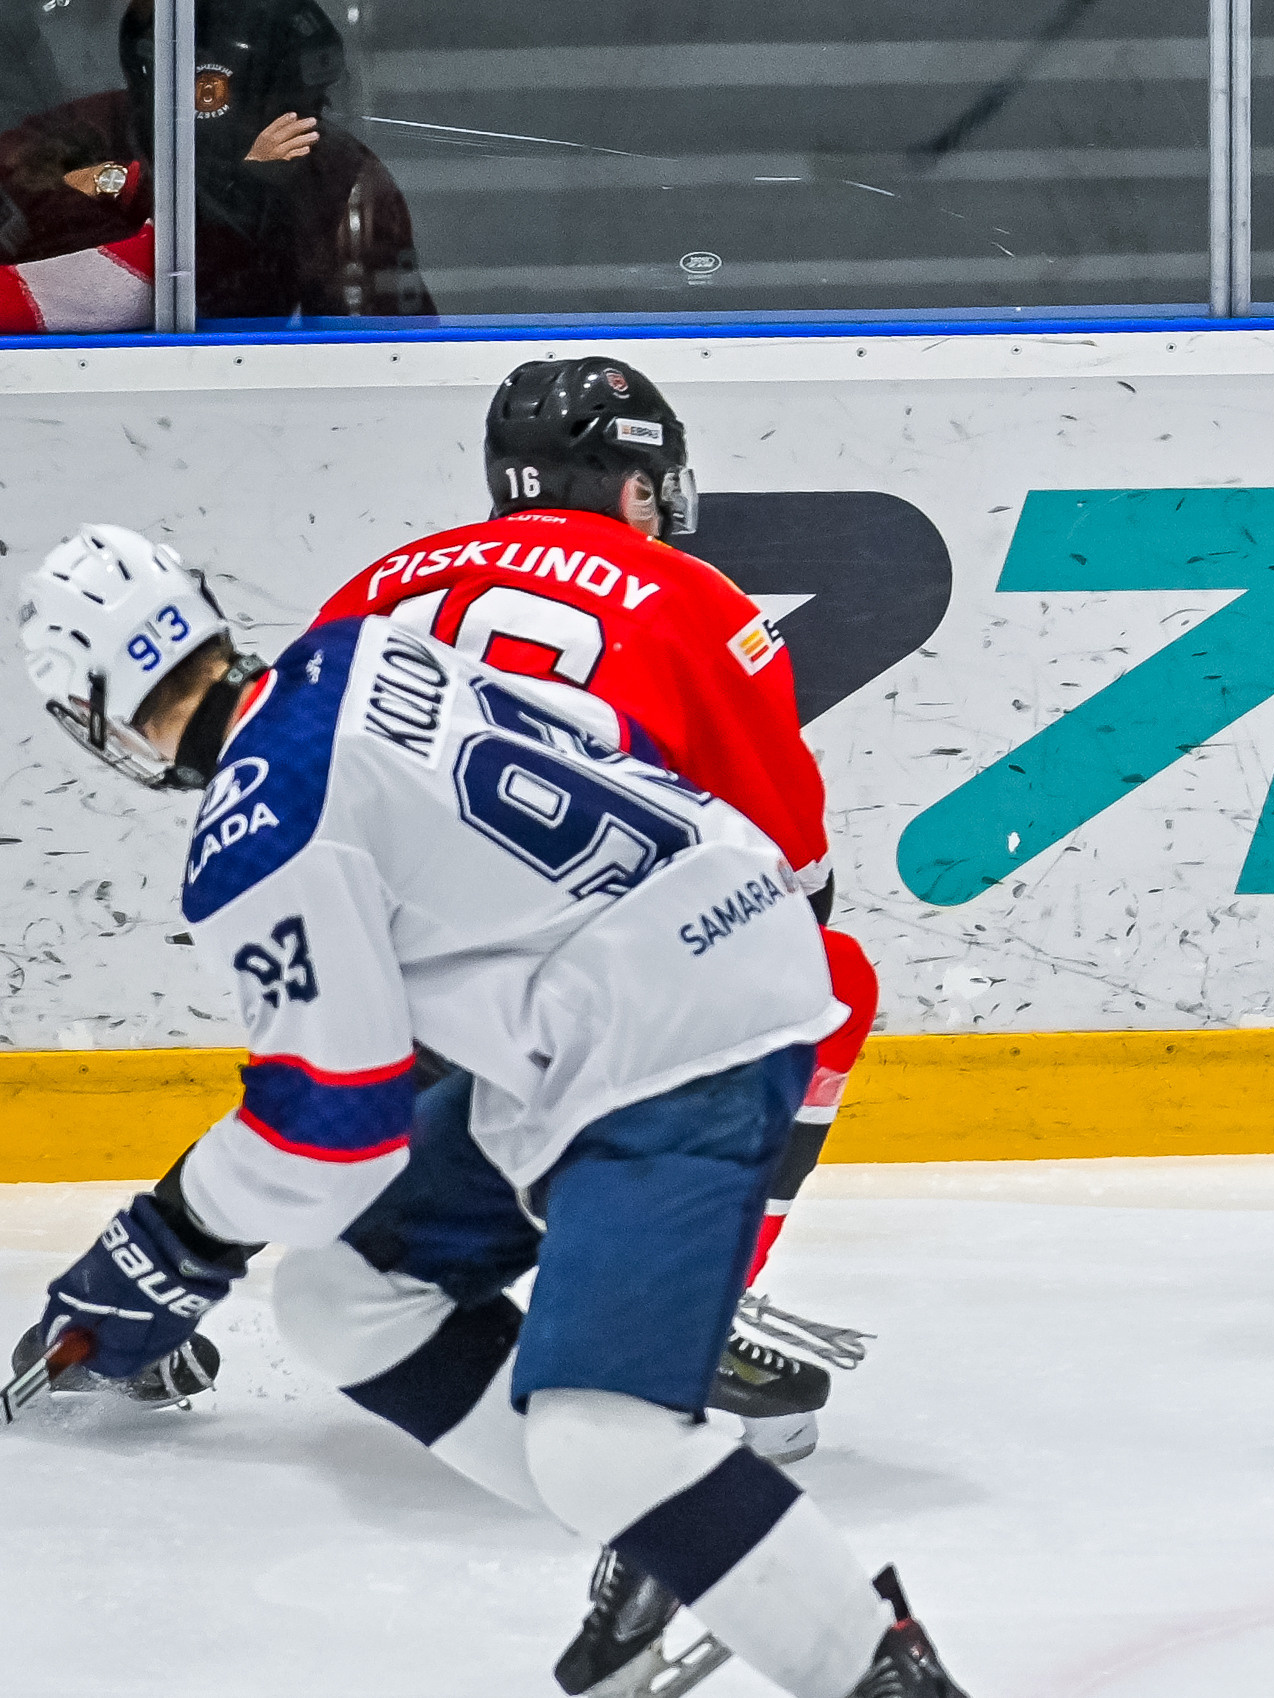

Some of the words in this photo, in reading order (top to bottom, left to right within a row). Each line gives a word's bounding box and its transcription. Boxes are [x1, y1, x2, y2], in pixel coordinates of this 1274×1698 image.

[504, 465, 542, 499] 16
[367, 540, 661, 611] PISKUNOV
[127, 604, 192, 672] 93
[187, 802, 281, 886] LADA
[679, 872, 787, 956] SAMARA
[99, 1216, 214, 1319] BAUE
